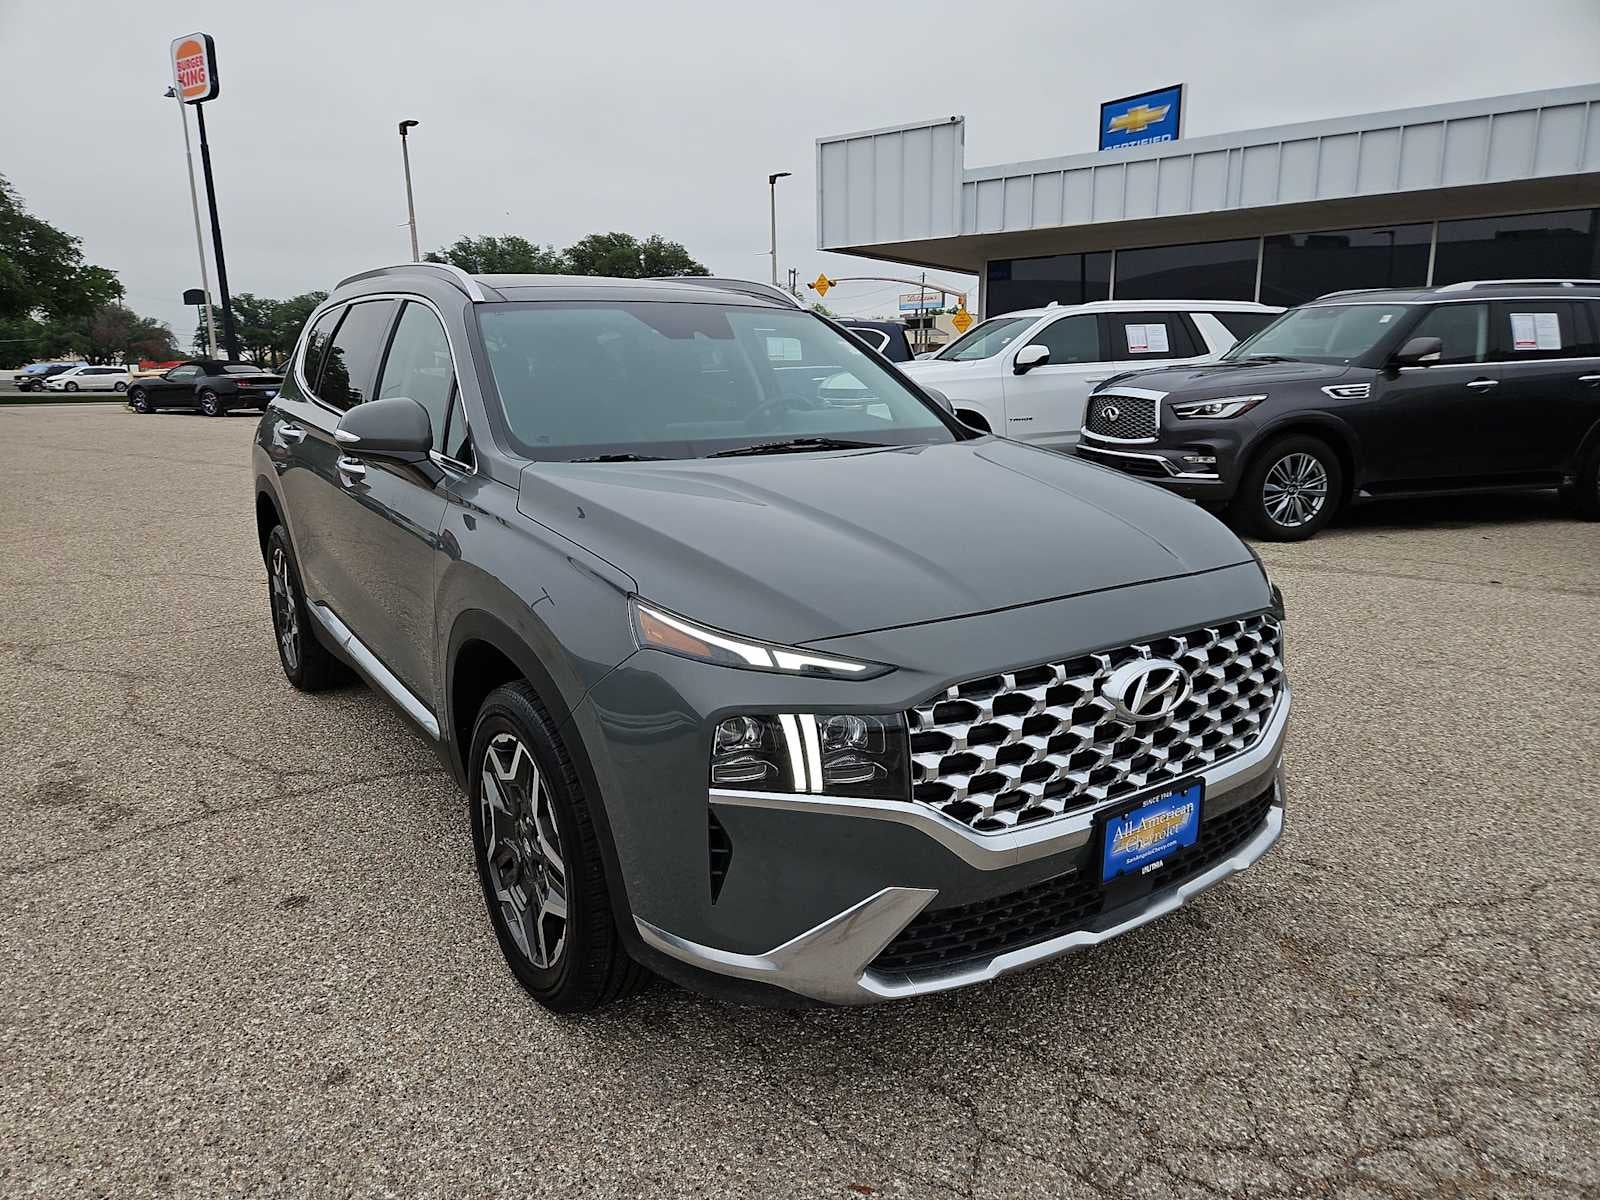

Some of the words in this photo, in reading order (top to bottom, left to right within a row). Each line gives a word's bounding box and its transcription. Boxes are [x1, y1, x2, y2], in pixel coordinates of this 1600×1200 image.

[177, 55, 204, 72] BURGER
[177, 67, 206, 87] KING
[1113, 820, 1133, 842] All
[1137, 802, 1194, 832] American
[1125, 822, 1179, 852] Chevrolet
